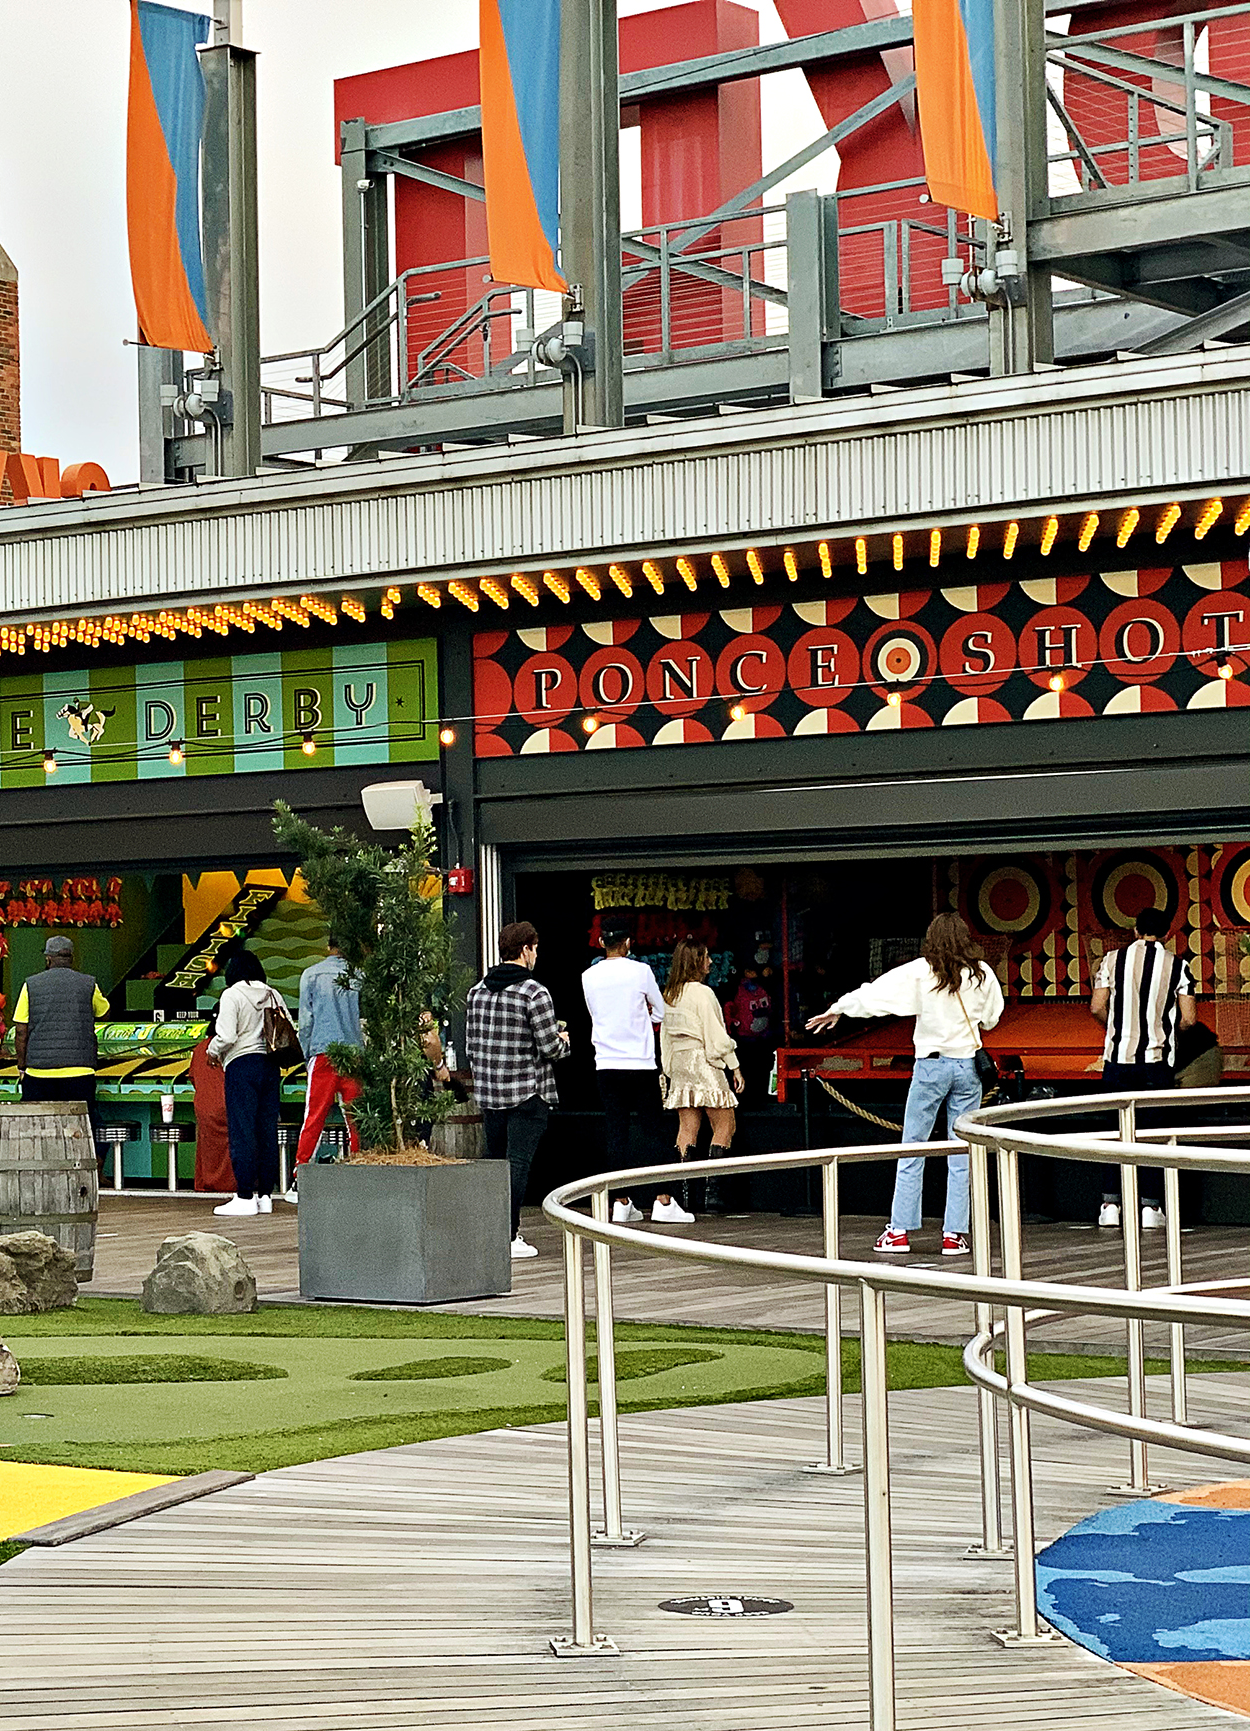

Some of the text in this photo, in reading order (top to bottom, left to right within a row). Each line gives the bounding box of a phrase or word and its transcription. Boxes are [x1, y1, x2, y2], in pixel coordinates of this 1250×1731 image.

[534, 610, 1244, 709] PONCE SHOT
[145, 682, 375, 741] DERBY
[165, 889, 275, 989] FINISH
